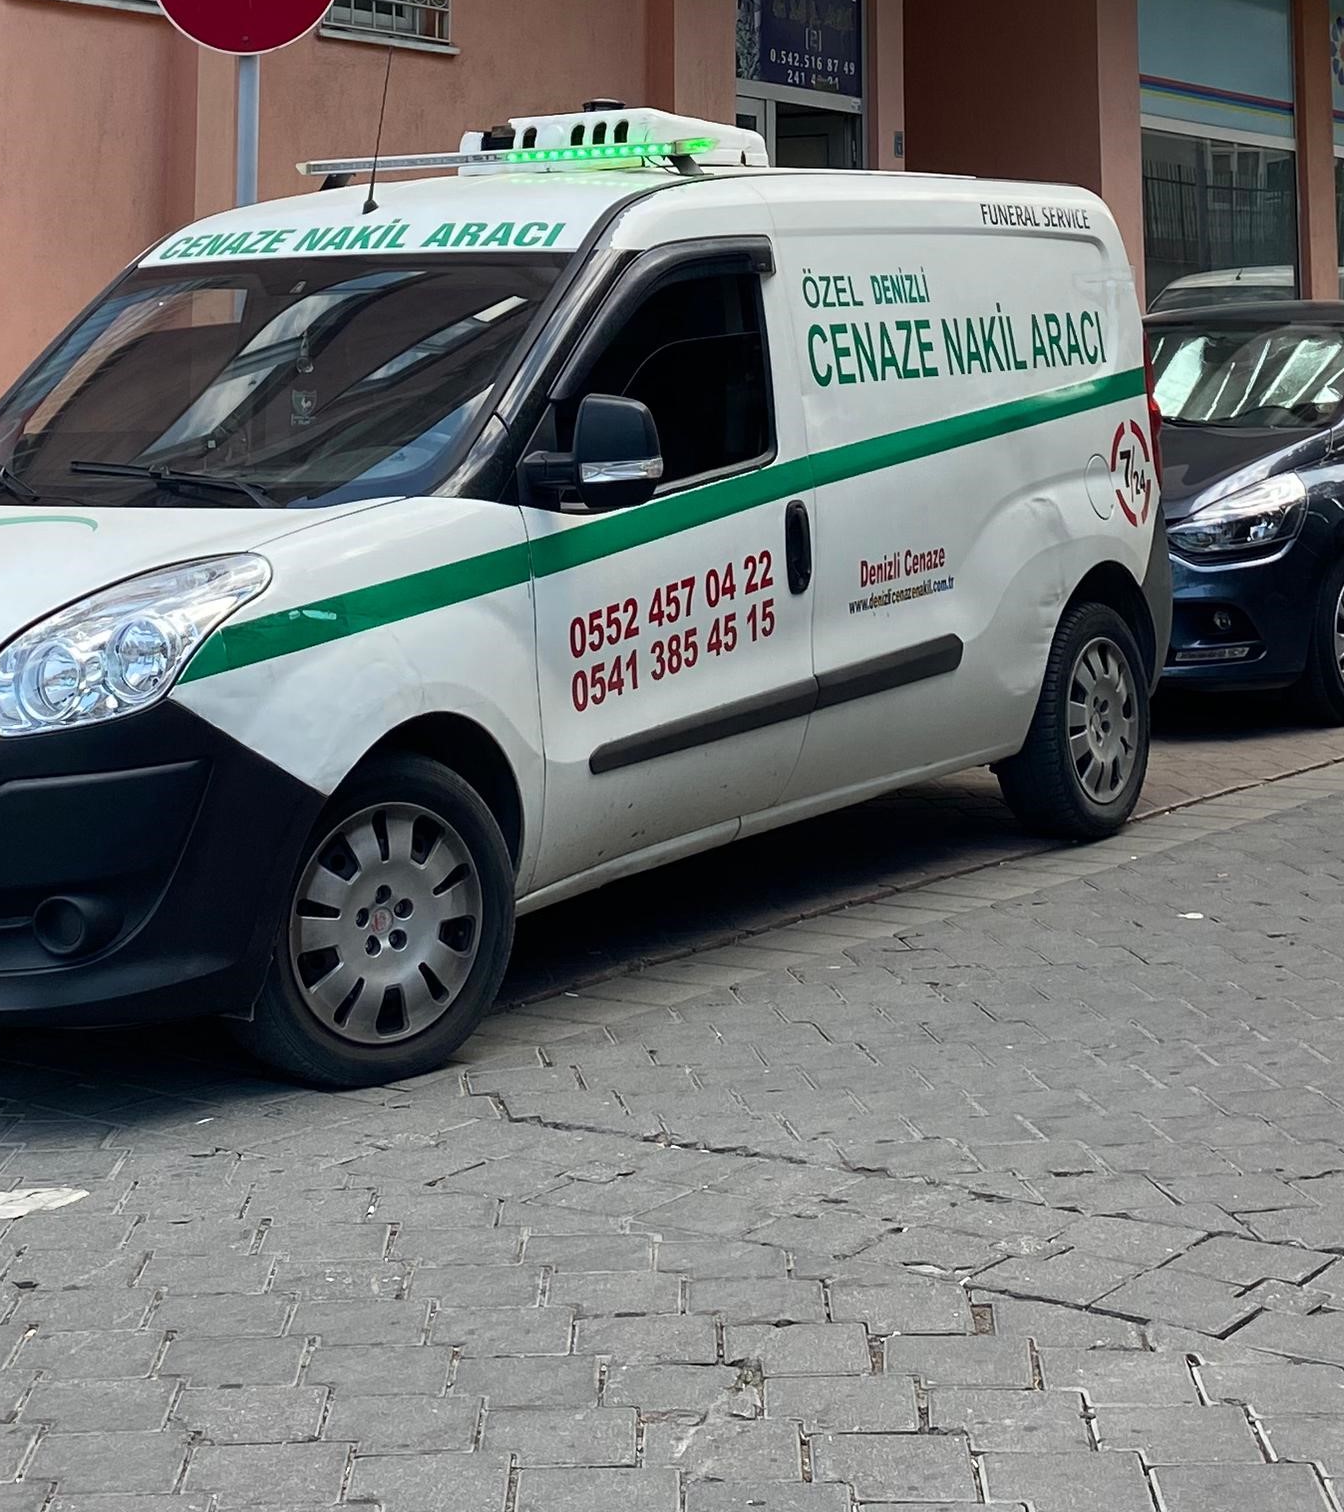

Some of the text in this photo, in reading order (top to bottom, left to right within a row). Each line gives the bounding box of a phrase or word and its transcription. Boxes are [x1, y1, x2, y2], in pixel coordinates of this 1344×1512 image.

[980, 203, 1090, 229] FUNERAL SERVICE
[159, 218, 567, 260] CENAZE NAKİL ARACI
[802, 267, 930, 309] ÖZEL DENİZLİ
[807, 302, 1107, 388] CENAZE NAKİL ARACI
[860, 547, 946, 588] Denizli Cenaze
[569, 550, 774, 658] 0552 457 04 22
[572, 598, 775, 712] 0541 385 45 15
